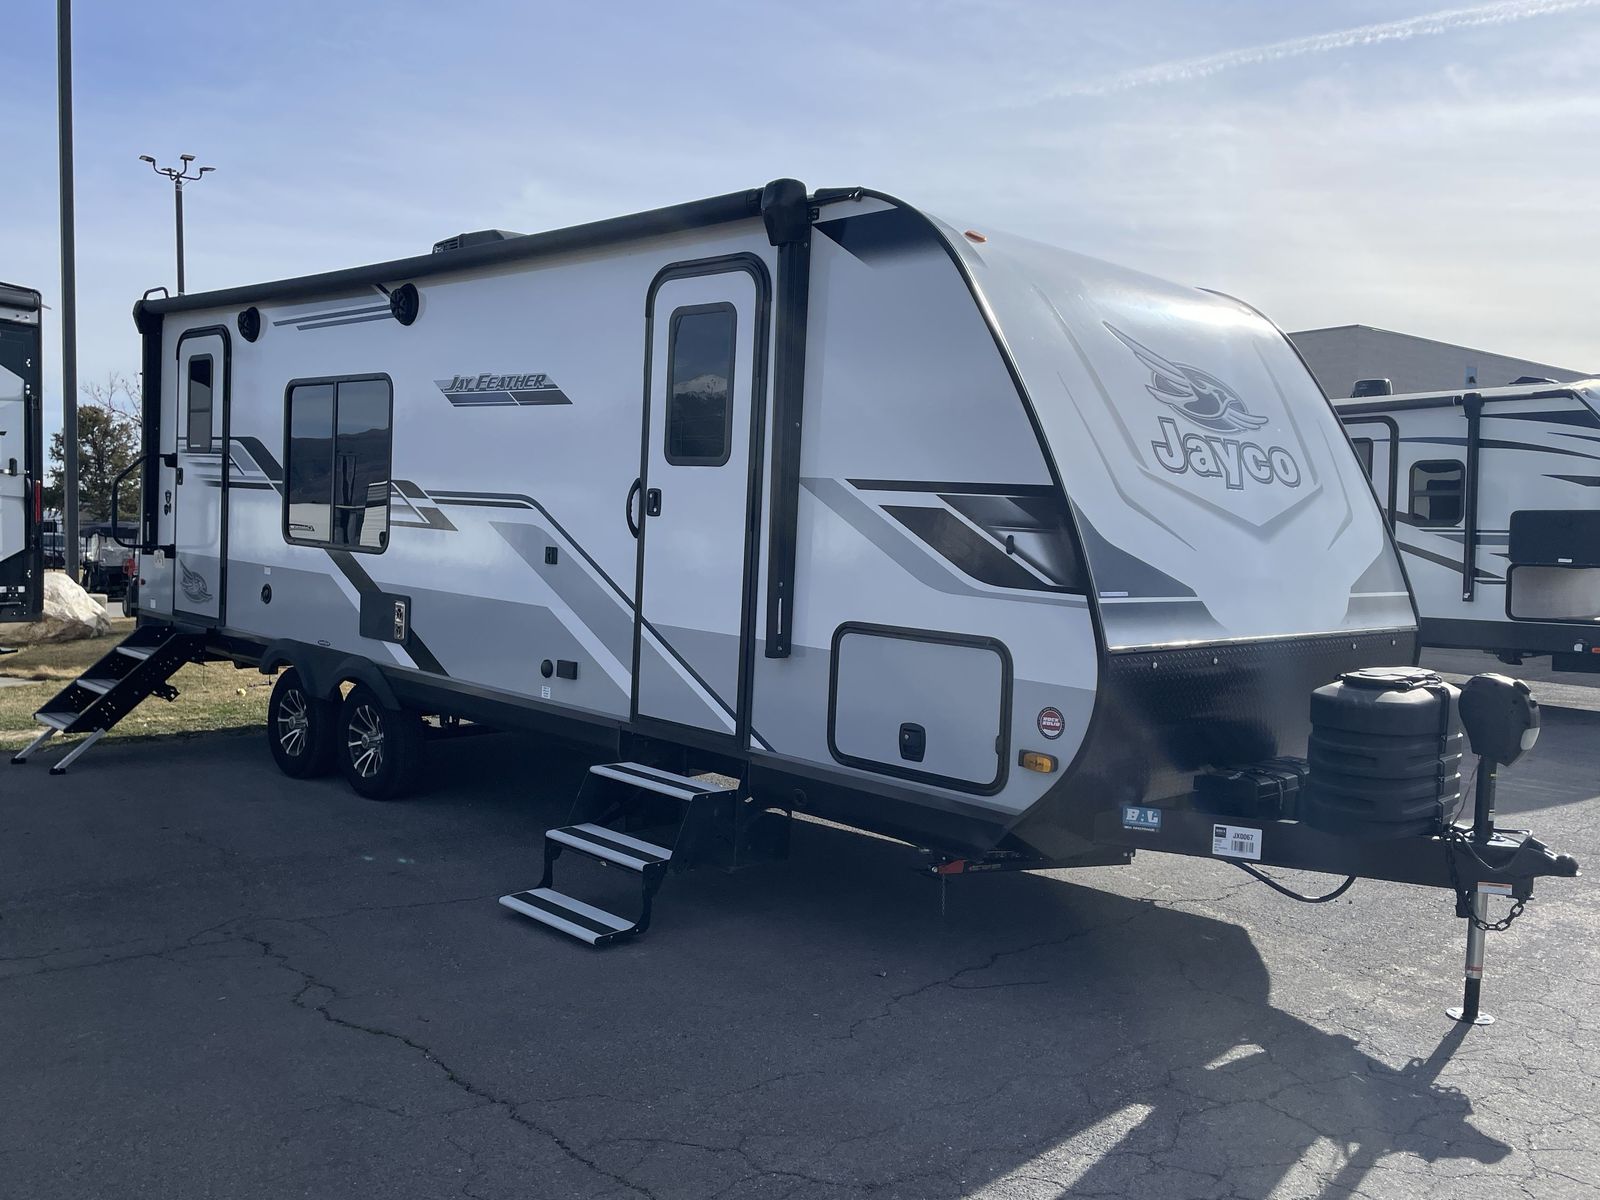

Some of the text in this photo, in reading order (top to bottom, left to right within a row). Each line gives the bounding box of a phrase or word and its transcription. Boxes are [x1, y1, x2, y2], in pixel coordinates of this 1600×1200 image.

[445, 373, 547, 391] JAY FEATHER
[1151, 416, 1301, 490] Jayco
